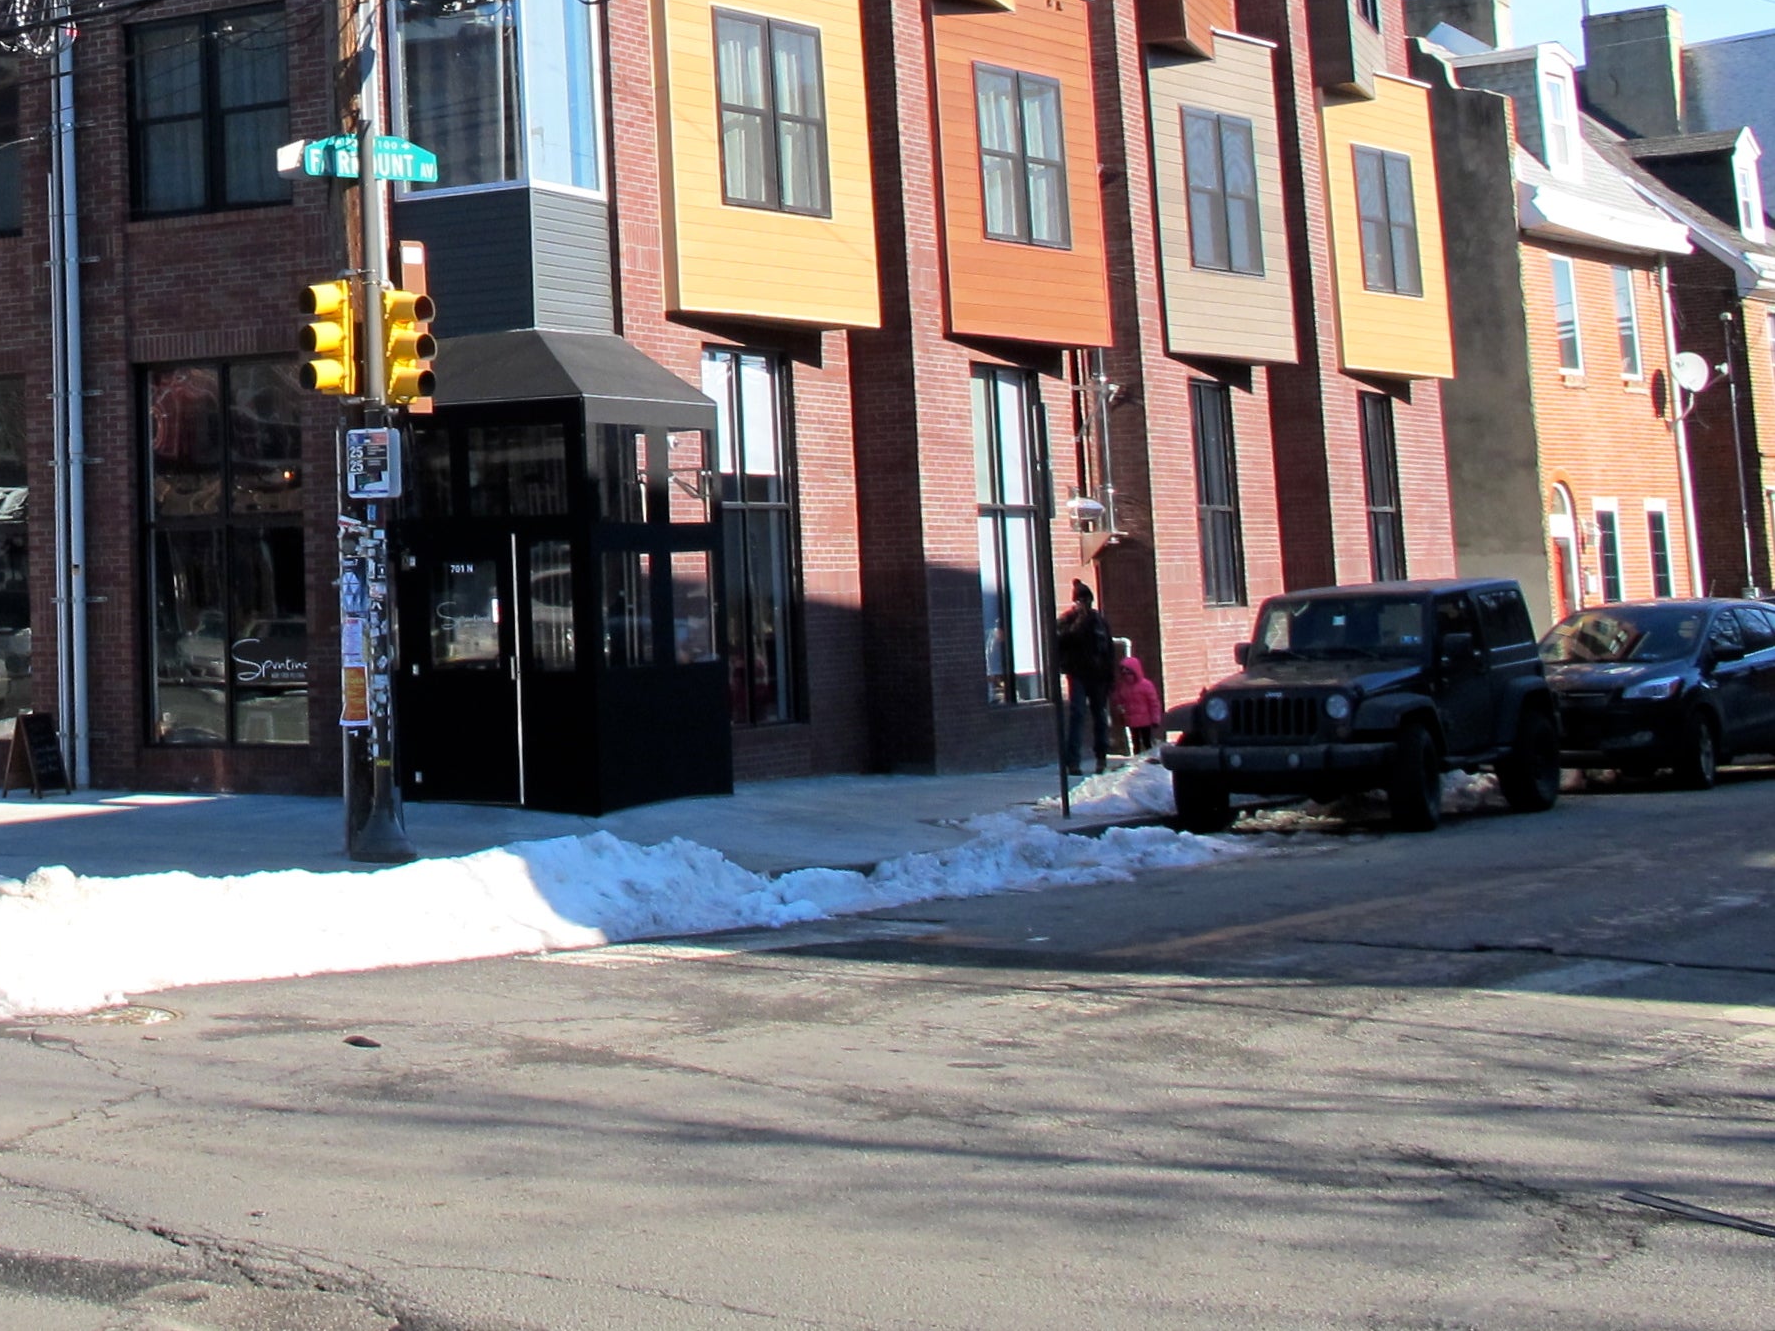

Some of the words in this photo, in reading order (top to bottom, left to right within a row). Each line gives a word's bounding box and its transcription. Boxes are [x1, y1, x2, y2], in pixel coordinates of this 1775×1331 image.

[378, 140, 398, 150] 100
[310, 148, 414, 178] FRUNT
[419, 162, 435, 179] AV
[349, 446, 364, 459] 25
[349, 459, 364, 472] 25
[450, 564, 465, 573] 701
[466, 564, 474, 573] N
